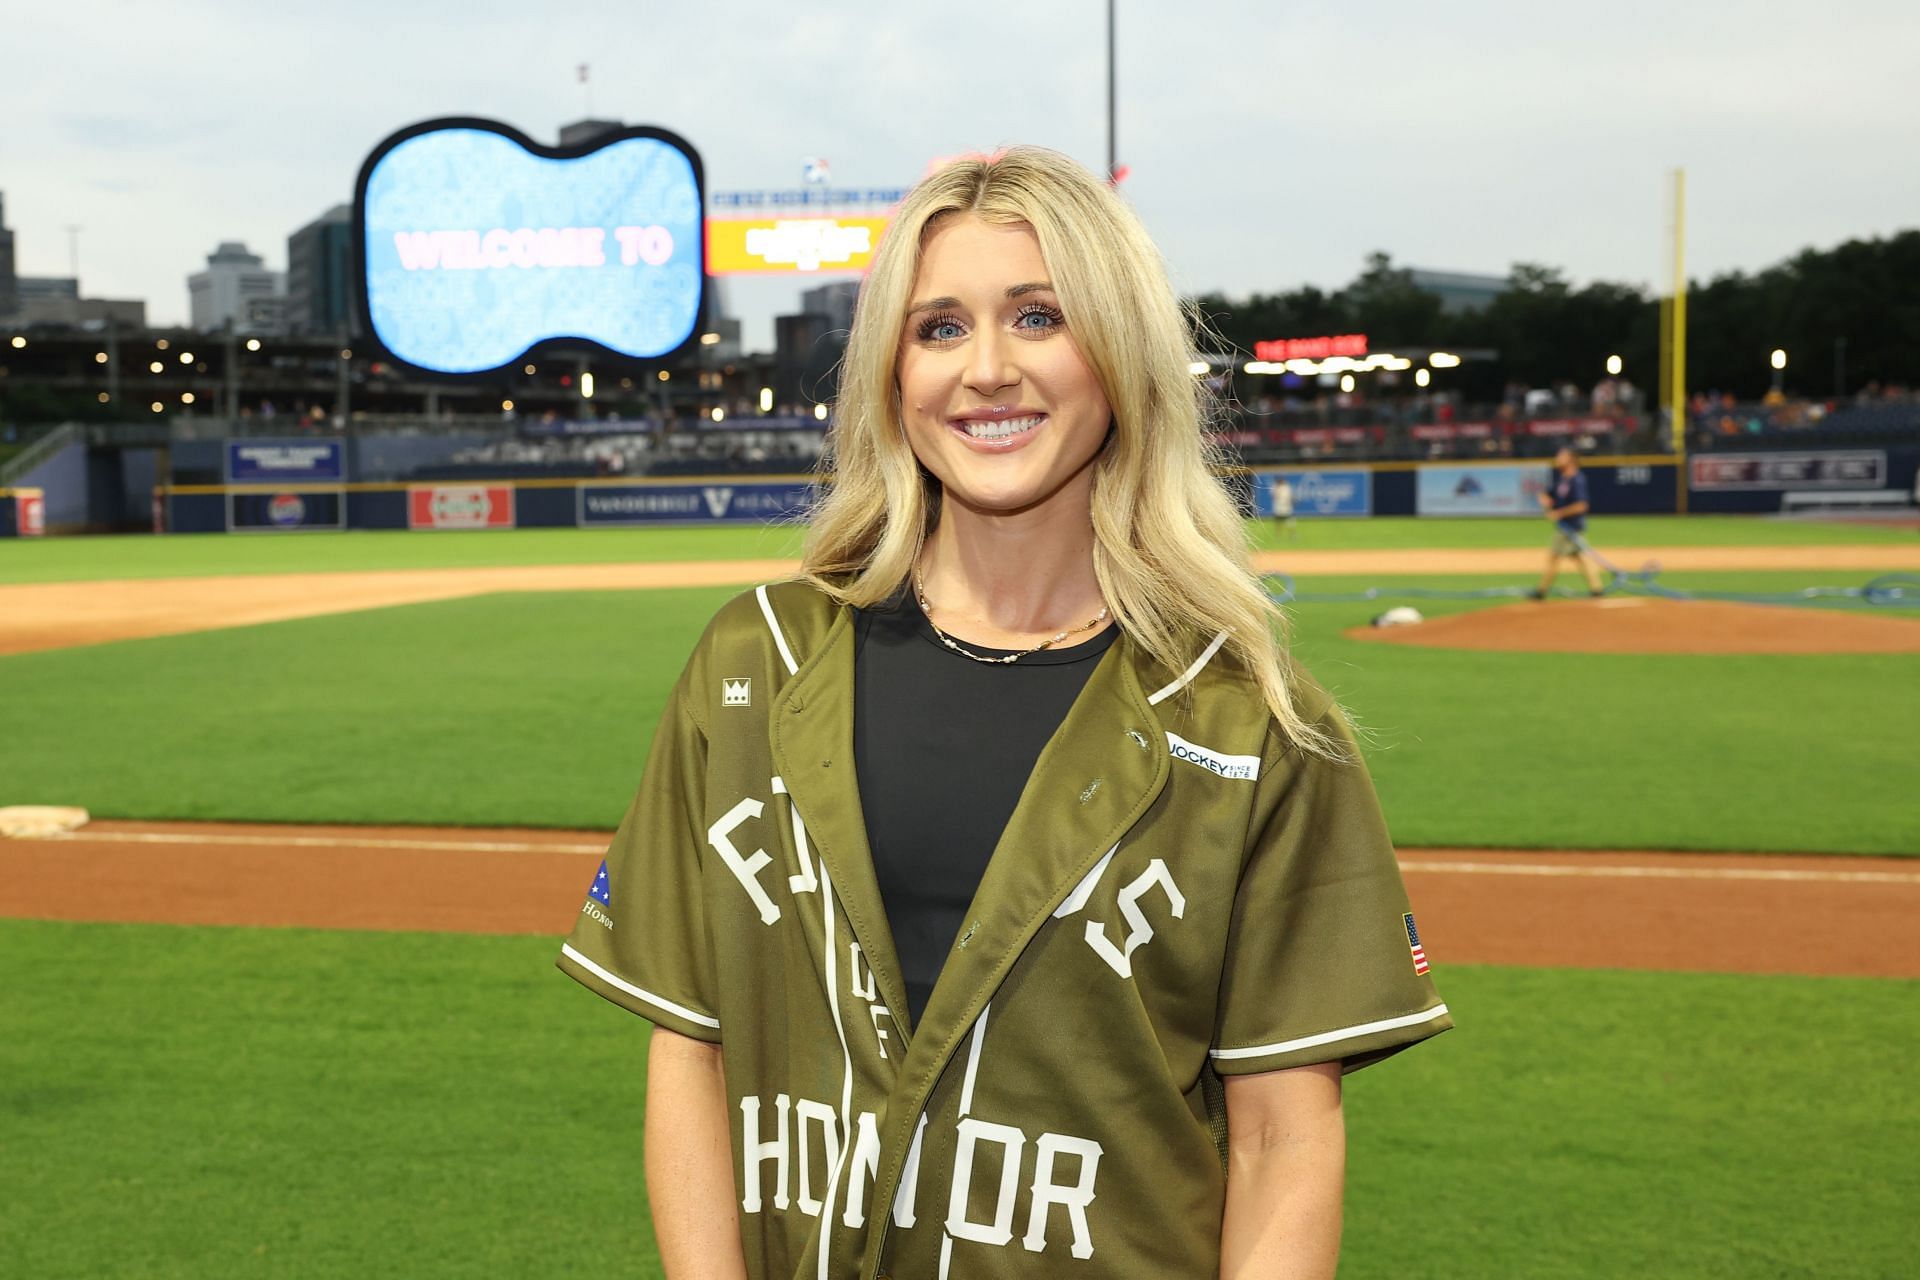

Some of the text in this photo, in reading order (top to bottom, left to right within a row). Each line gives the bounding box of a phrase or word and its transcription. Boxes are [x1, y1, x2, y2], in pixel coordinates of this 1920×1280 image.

[394, 224, 674, 270] WELCOME TO
[1170, 744, 1229, 775] JOCKEY
[582, 901, 614, 930] HONOR
[739, 1093, 1104, 1260] HONOR
